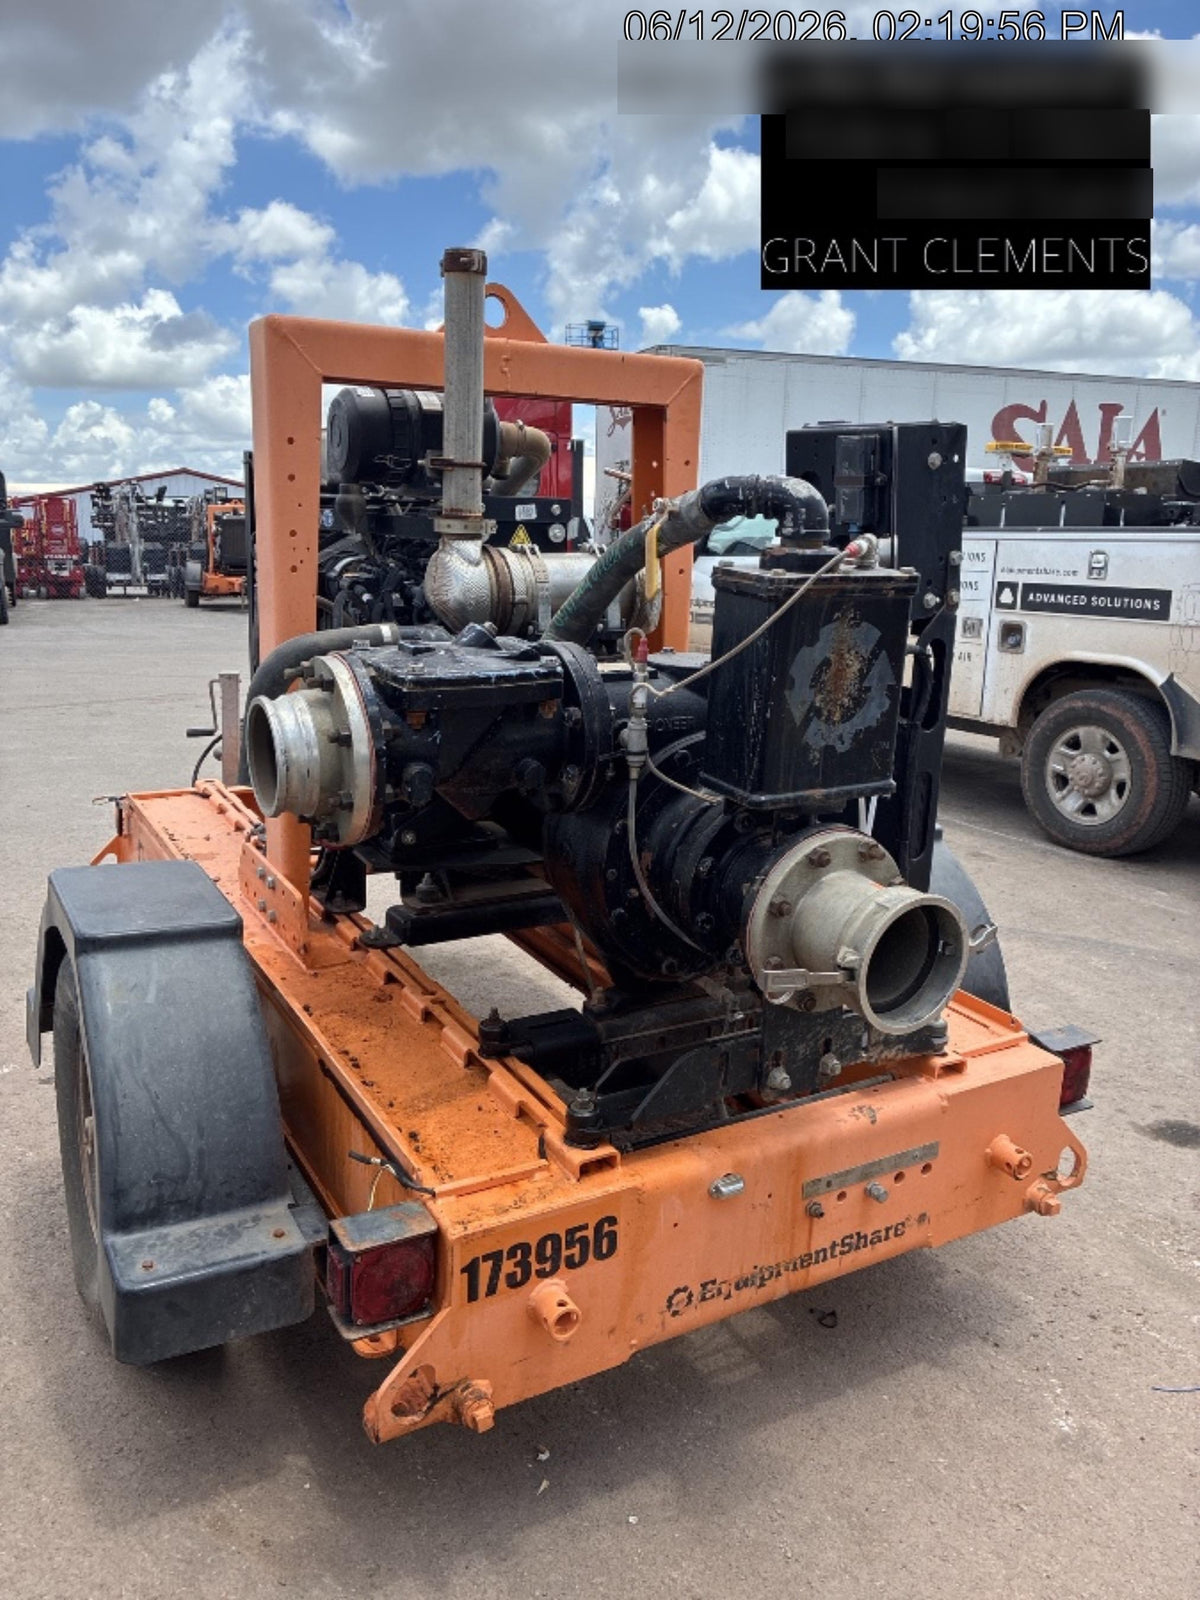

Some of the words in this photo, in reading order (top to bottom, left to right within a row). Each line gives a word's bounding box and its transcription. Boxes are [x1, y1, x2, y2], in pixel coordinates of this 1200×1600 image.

[990, 398, 1163, 473] SAIA
[1027, 592, 1088, 606] ADVANCED
[1090, 595, 1161, 611] SOLUTIONS
[460, 1214, 619, 1304] 173956
[698, 1220, 907, 1303] EquipmentShare
